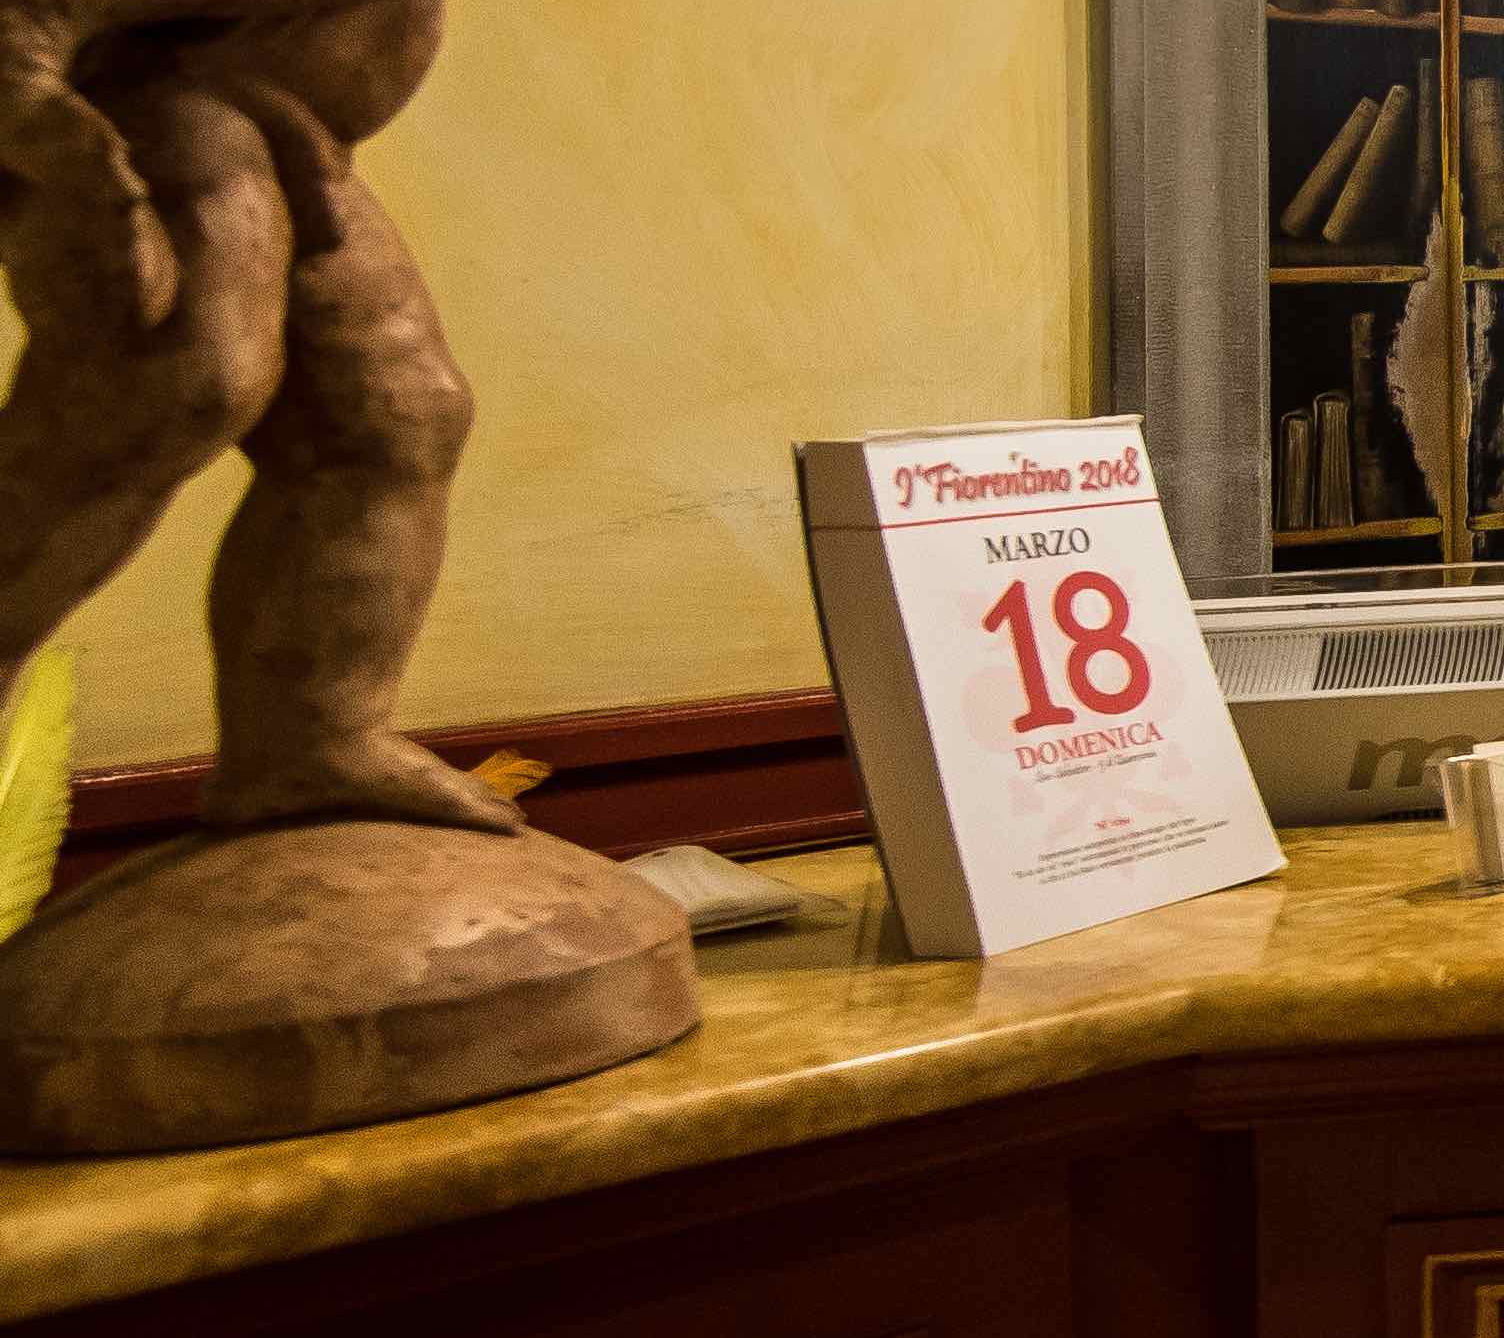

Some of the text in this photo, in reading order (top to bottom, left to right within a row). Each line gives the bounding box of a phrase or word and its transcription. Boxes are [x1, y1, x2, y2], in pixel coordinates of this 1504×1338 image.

[1080, 447, 1140, 491] 2018
[984, 527, 1090, 564] MARZO
[982, 571, 1151, 733] 18
[1014, 721, 1164, 770] DOMENICA
